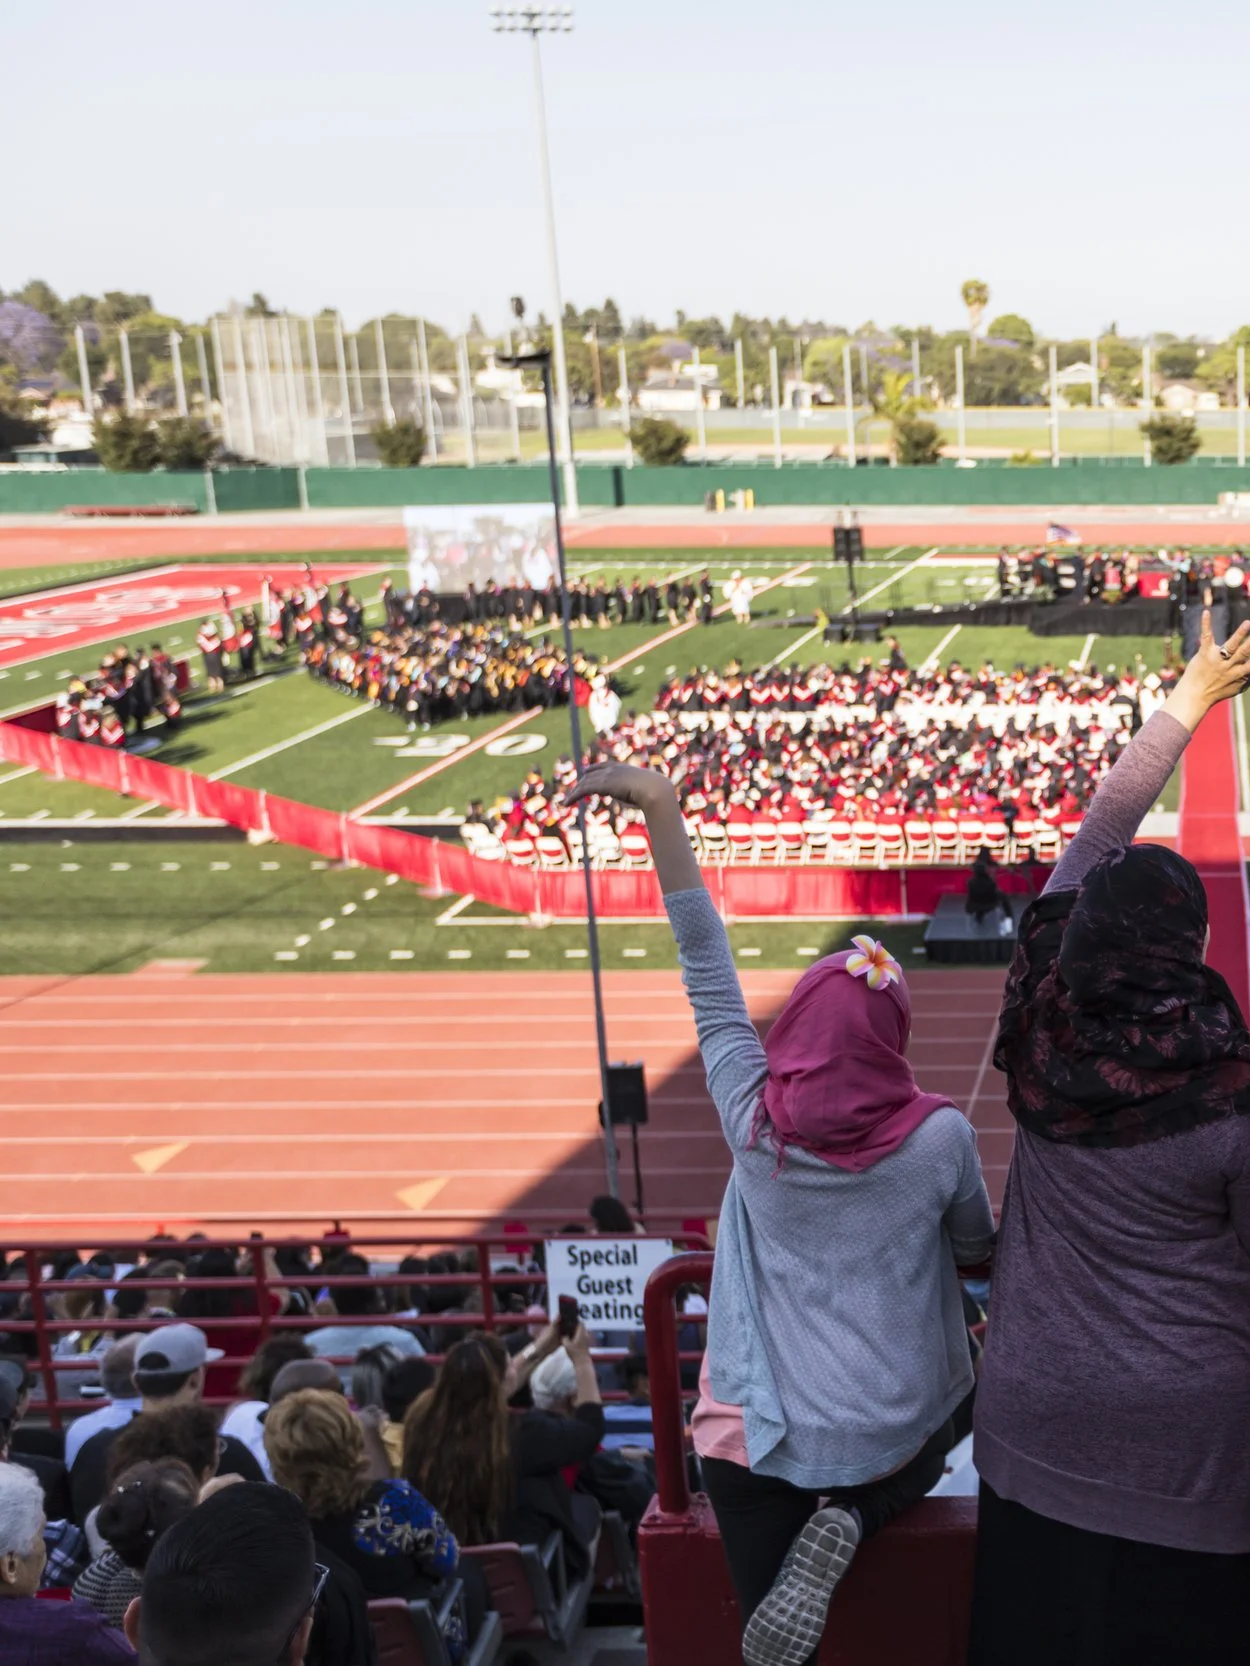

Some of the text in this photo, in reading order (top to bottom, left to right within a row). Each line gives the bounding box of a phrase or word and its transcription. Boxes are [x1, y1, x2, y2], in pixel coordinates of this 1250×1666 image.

[567, 1244, 638, 1271] Special
[577, 1274, 633, 1295] Guest
[579, 1298, 645, 1325] eating
